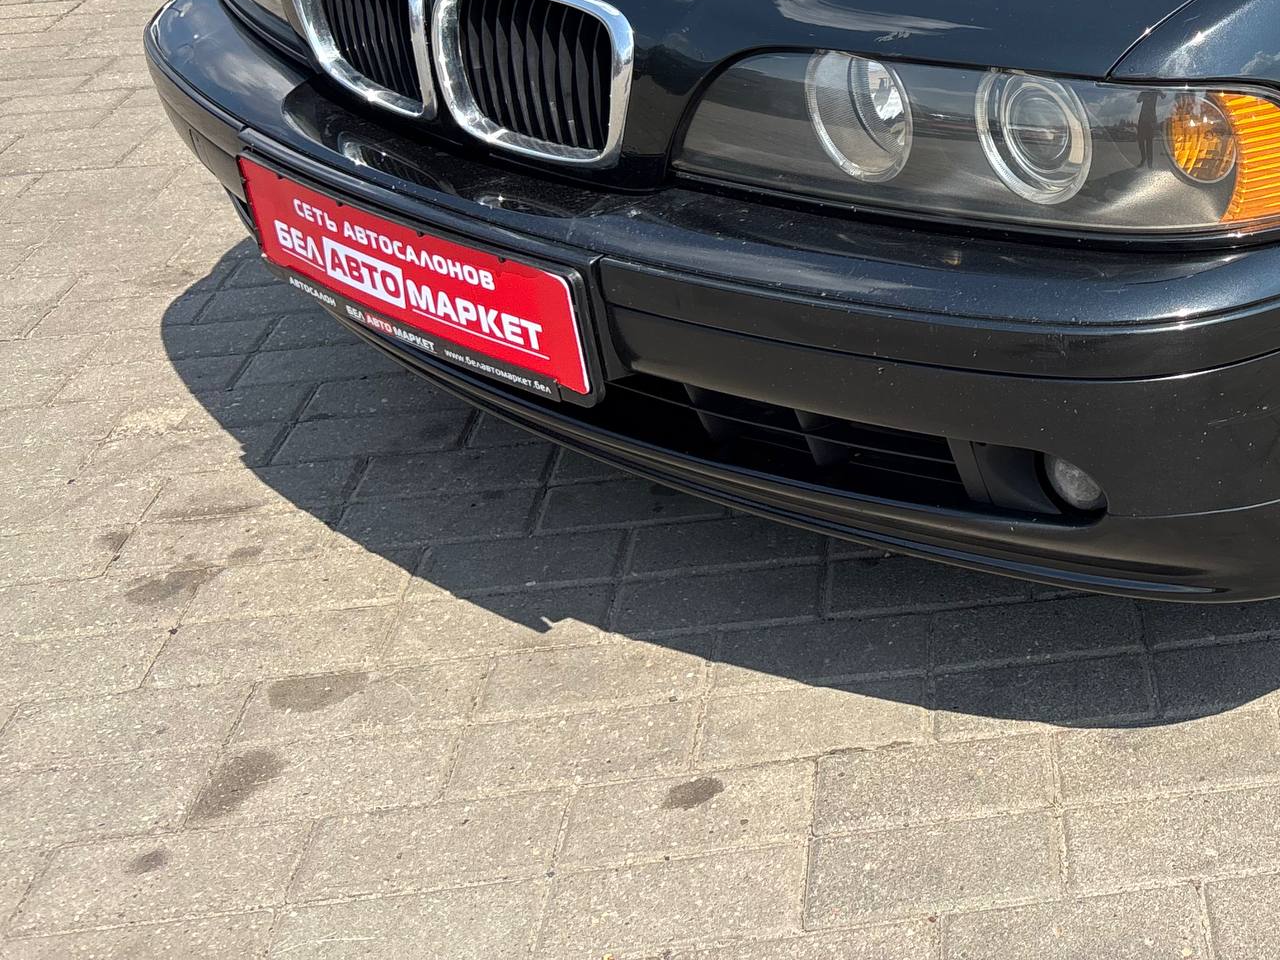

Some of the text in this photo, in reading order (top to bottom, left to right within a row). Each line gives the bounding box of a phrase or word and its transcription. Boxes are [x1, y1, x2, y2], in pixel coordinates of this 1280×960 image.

[274, 219, 543, 351] БЕЛ АВТО МАРКЕТ
[293, 198, 496, 291] СЕТЬ АВТОСАЛОНОВ
[289, 276, 337, 308] АВТОСАЛОН
[345, 304, 366, 321] БЕЛ
[393, 326, 435, 352] МАРКЕТ
